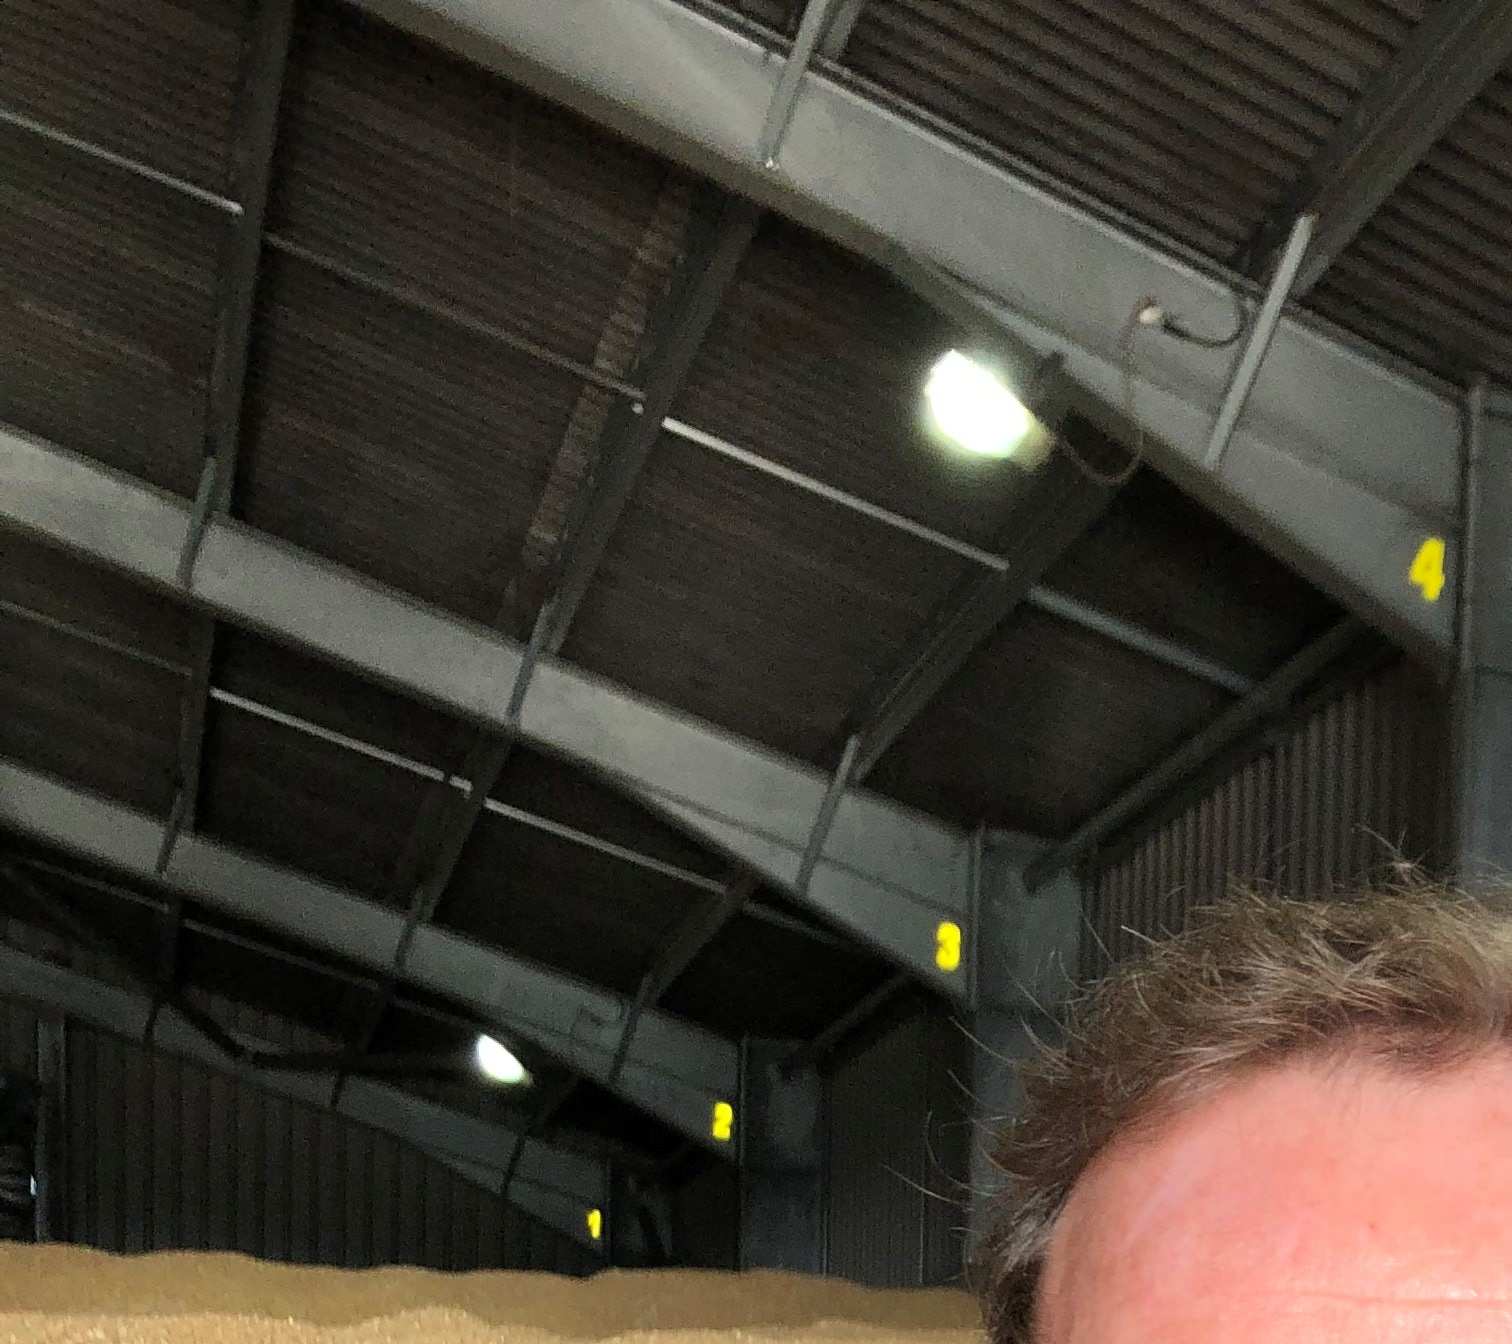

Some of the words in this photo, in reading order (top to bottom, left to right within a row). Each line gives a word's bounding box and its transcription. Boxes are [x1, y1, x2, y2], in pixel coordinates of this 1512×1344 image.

[1409, 536, 1446, 602] 4
[935, 920, 962, 972] 3
[711, 1101, 733, 1141] 2
[586, 1208, 602, 1239] 1
